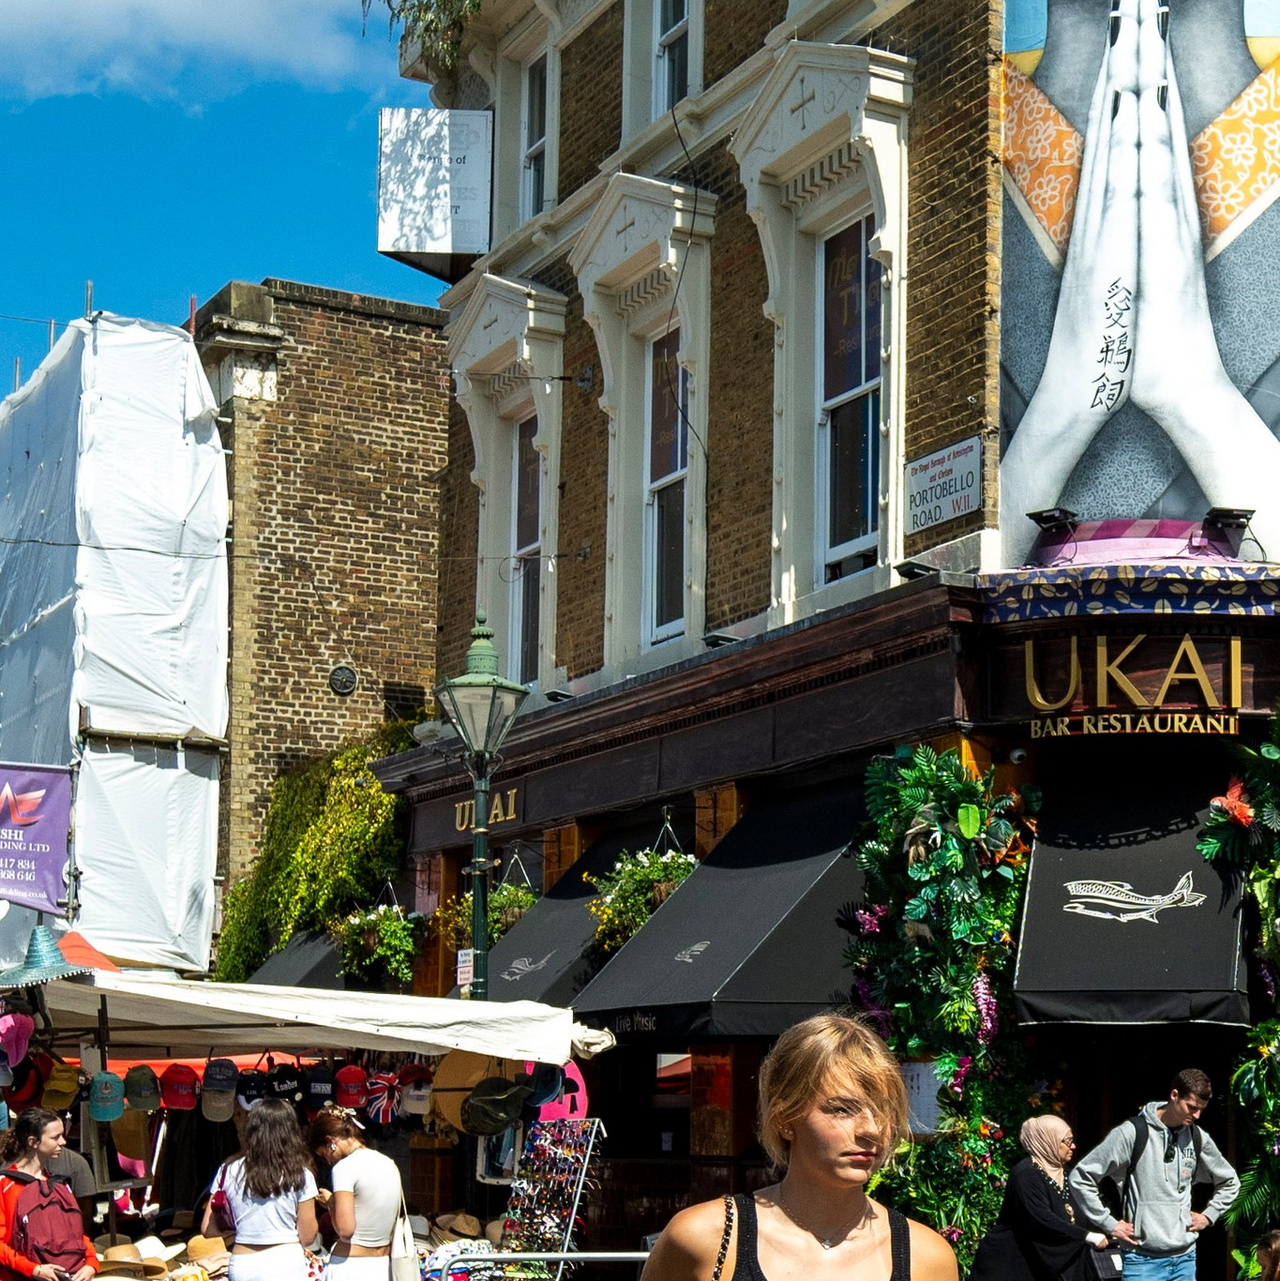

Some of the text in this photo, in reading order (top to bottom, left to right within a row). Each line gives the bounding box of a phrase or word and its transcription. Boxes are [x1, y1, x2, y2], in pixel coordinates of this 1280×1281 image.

[456, 155, 466, 165] of
[909, 471, 975, 510] PORTOBELLO
[912, 505, 944, 530] ROAD.
[1025, 633, 1242, 710] UKAI
[1030, 713, 1239, 739] BAR RESTAURANT
[0, 828, 24, 841] SHI
[29, 842, 50, 853] LTD
[633, 1010, 656, 1031] Music
